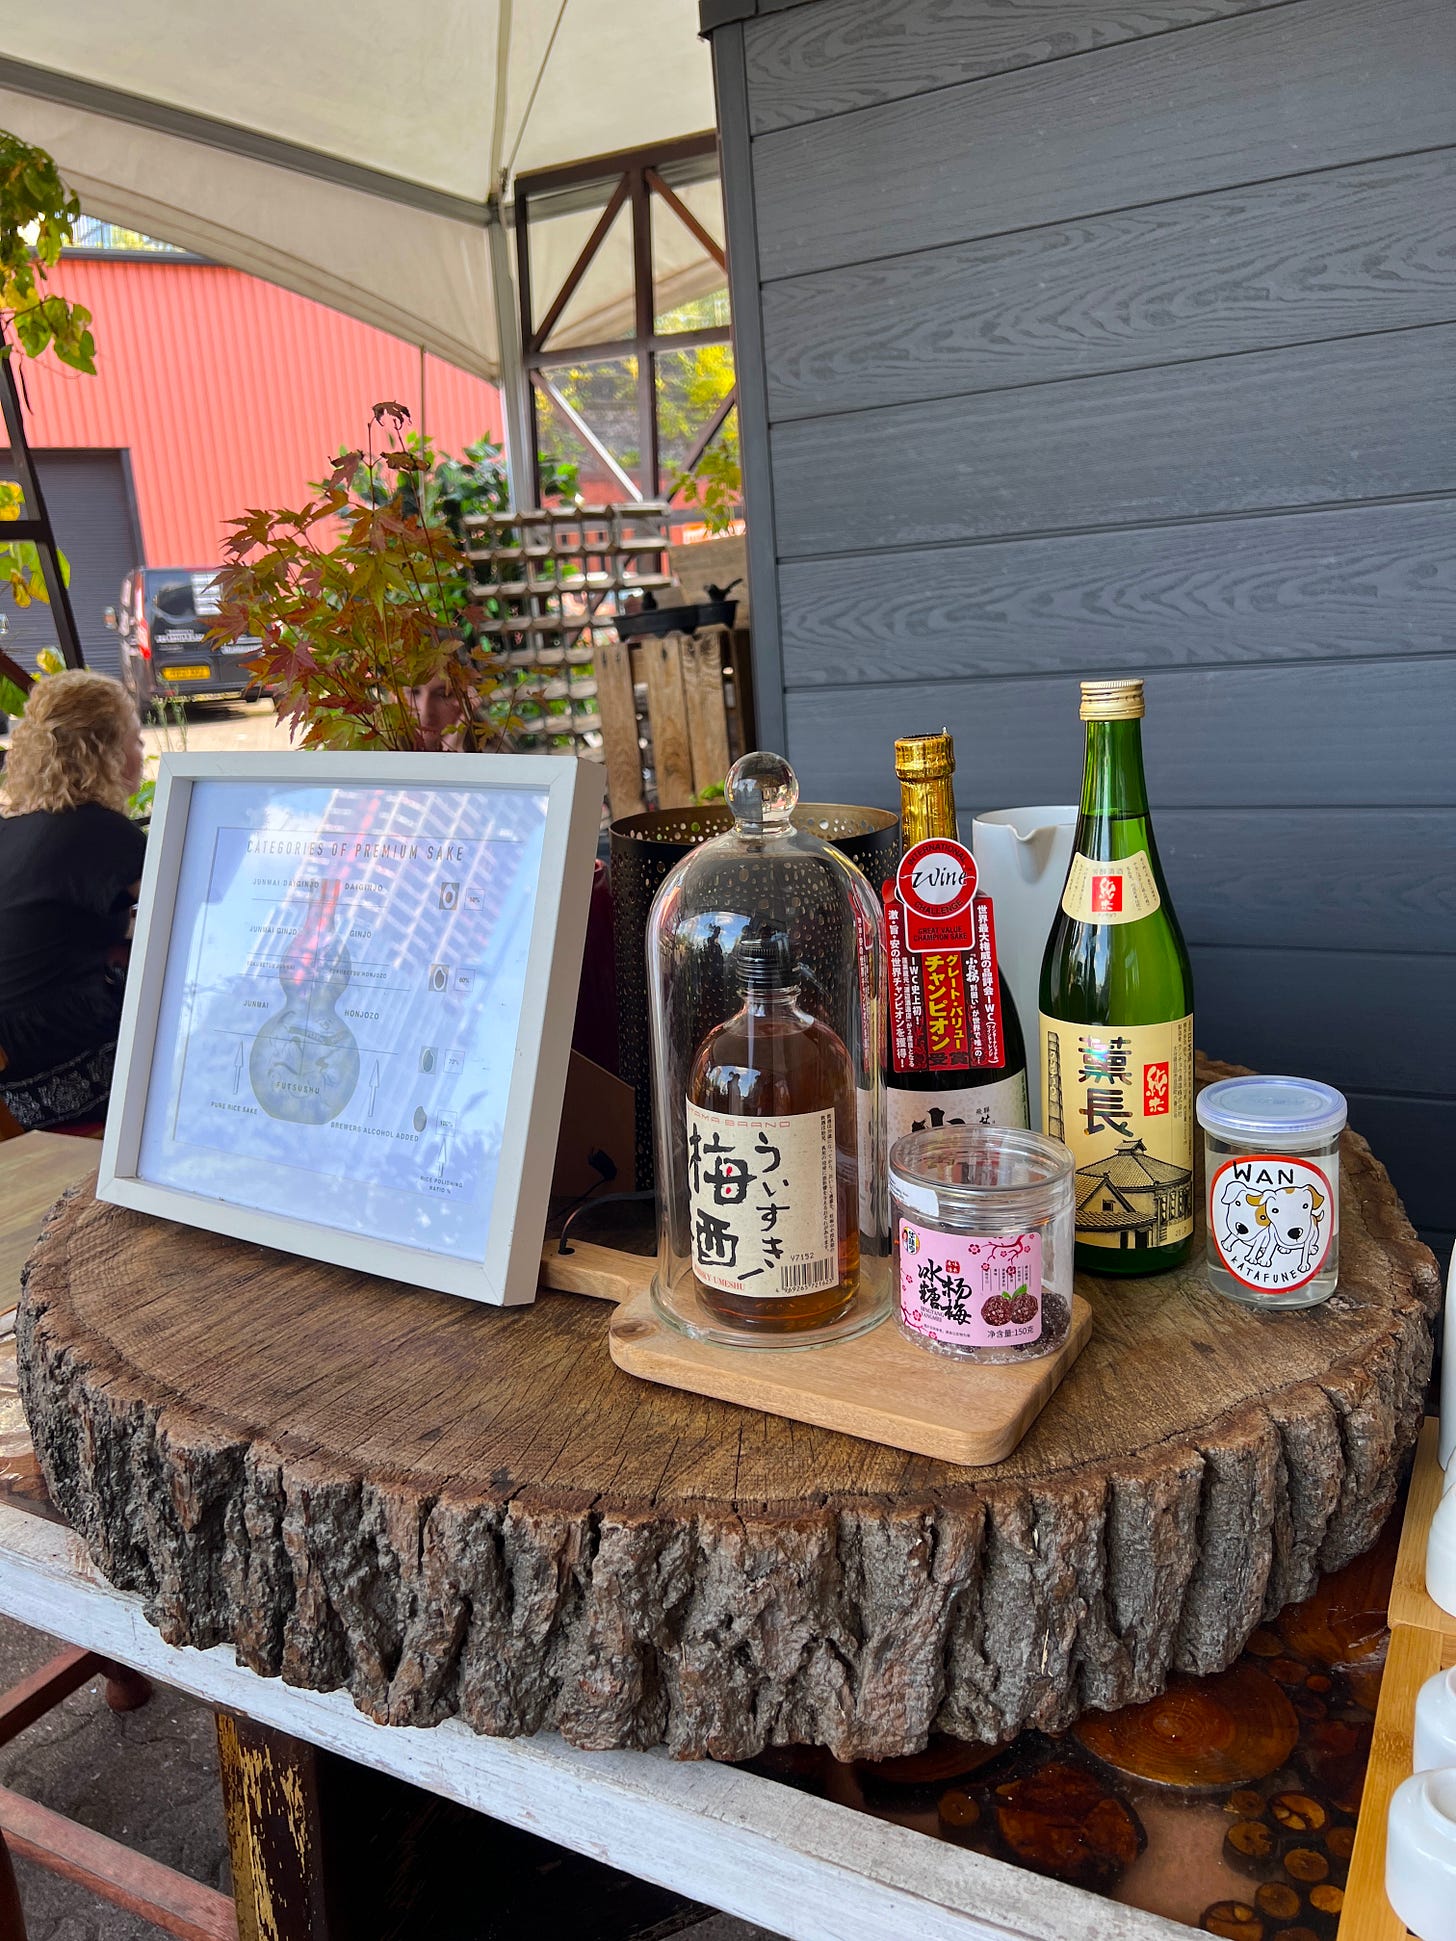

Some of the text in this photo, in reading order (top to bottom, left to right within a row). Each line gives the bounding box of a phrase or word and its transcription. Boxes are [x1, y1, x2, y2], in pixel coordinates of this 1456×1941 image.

[247, 839, 464, 861] CATEGORIES OF PREMIUM SAKE
[907, 843, 967, 866] INTERNATIONAL
[253, 878, 320, 889] JUNMAI DAIGINJO
[911, 867, 967, 888] Wine
[344, 883, 383, 892] DAIGINJO
[914, 899, 963, 915] CHALLENGE
[249, 924, 298, 935] JUNMAI GINJO
[349, 929, 372, 938] GINJO
[914, 934, 949, 942] CHAMPION
[243, 1000, 269, 1009] JUNMAI
[924, 955, 950, 1051] チャンピオン
[946, 955, 964, 1049] グレート・バリュー
[344, 1009, 380, 1020] HONJOZO
[276, 1081, 320, 1095] FUTSUSHU
[211, 1101, 257, 1115] PURE RICE SAKE
[330, 1121, 419, 1142] BREWERS ALCOHOL ADDED
[1233, 1161, 1294, 1185] WAN
[1230, 1255, 1297, 1284] KATAFUNE
[713, 1276, 745, 1291] UMESHU
[987, 1325, 1034, 1338] 净含量:150克
